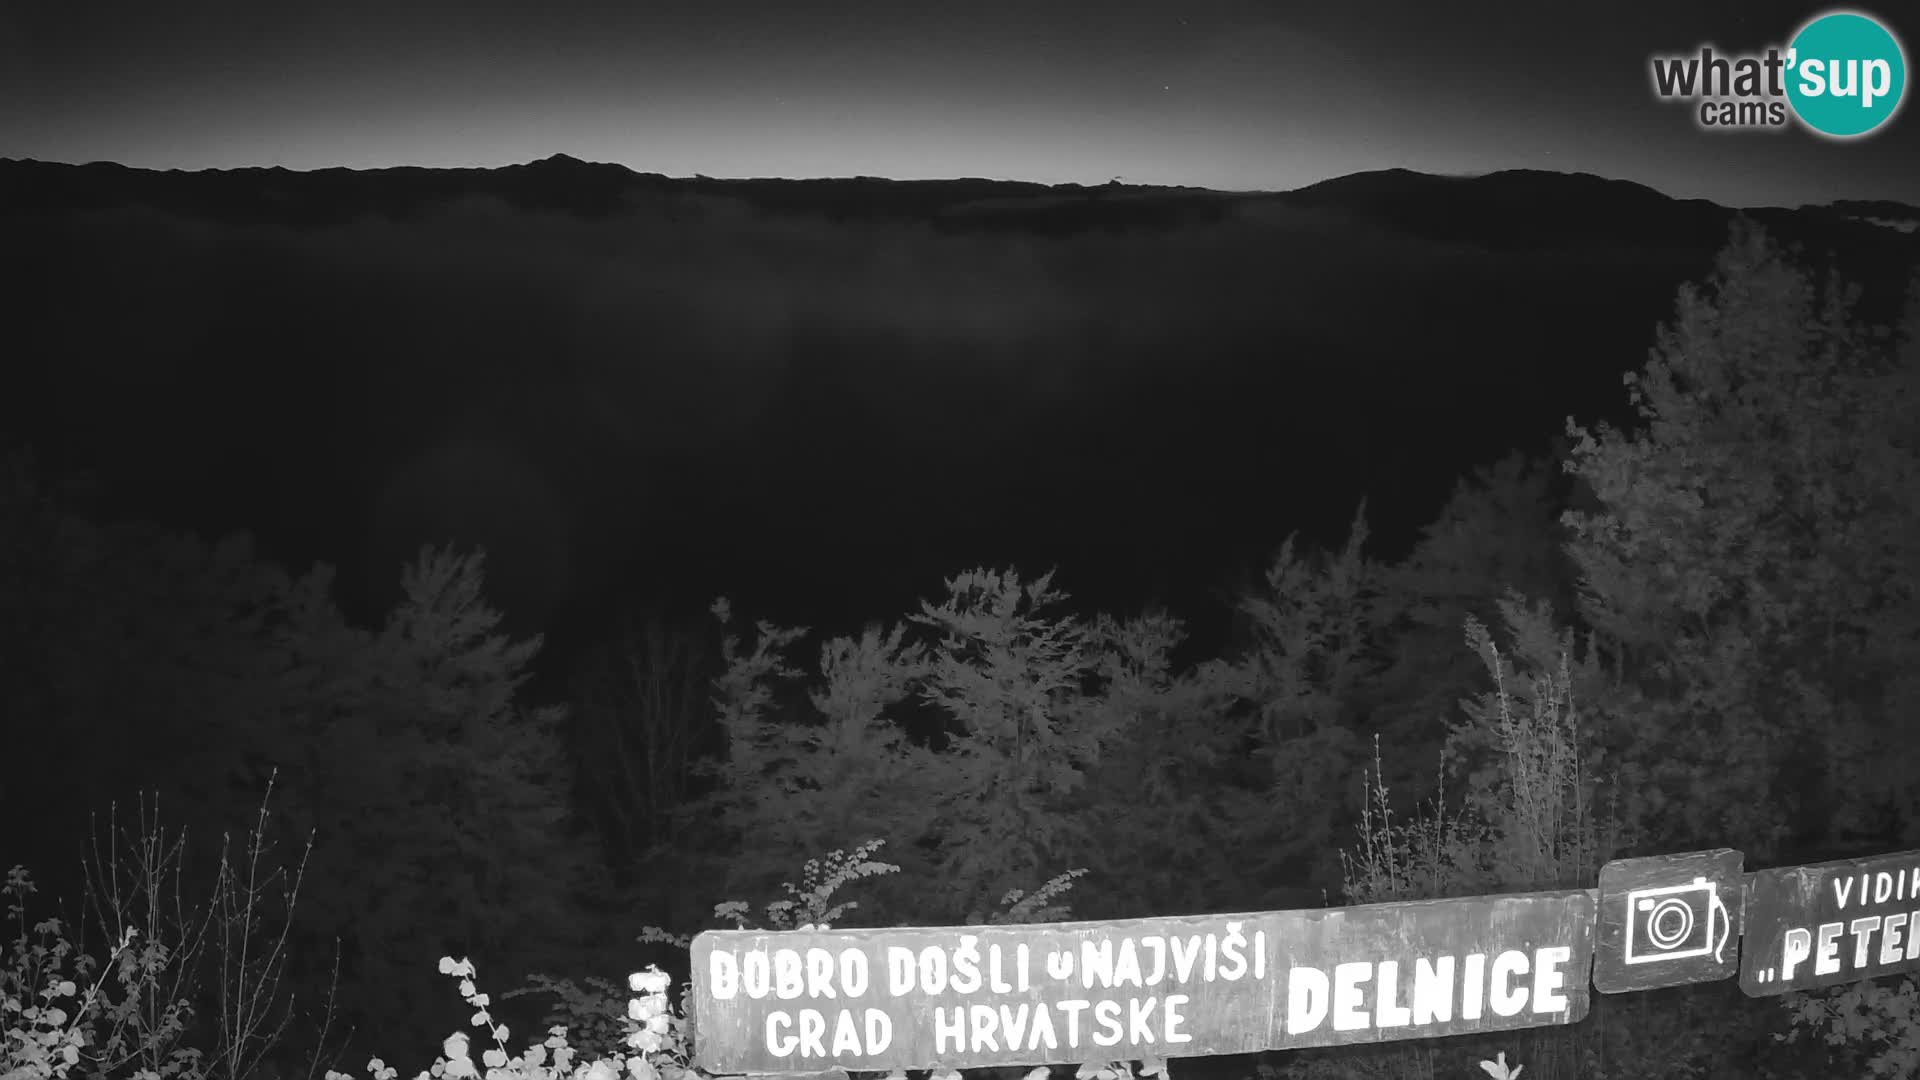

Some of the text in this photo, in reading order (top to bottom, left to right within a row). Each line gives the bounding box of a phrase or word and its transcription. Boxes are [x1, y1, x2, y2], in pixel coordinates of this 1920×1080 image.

[710, 948, 869, 1000] DOBRO
[888, 935, 1029, 997] DOŠLI
[1081, 922, 1265, 989] NAJVIŠI
[1287, 946, 1570, 1035] DELNICE
[766, 994, 1192, 1057] GRAD HRVATSKE
